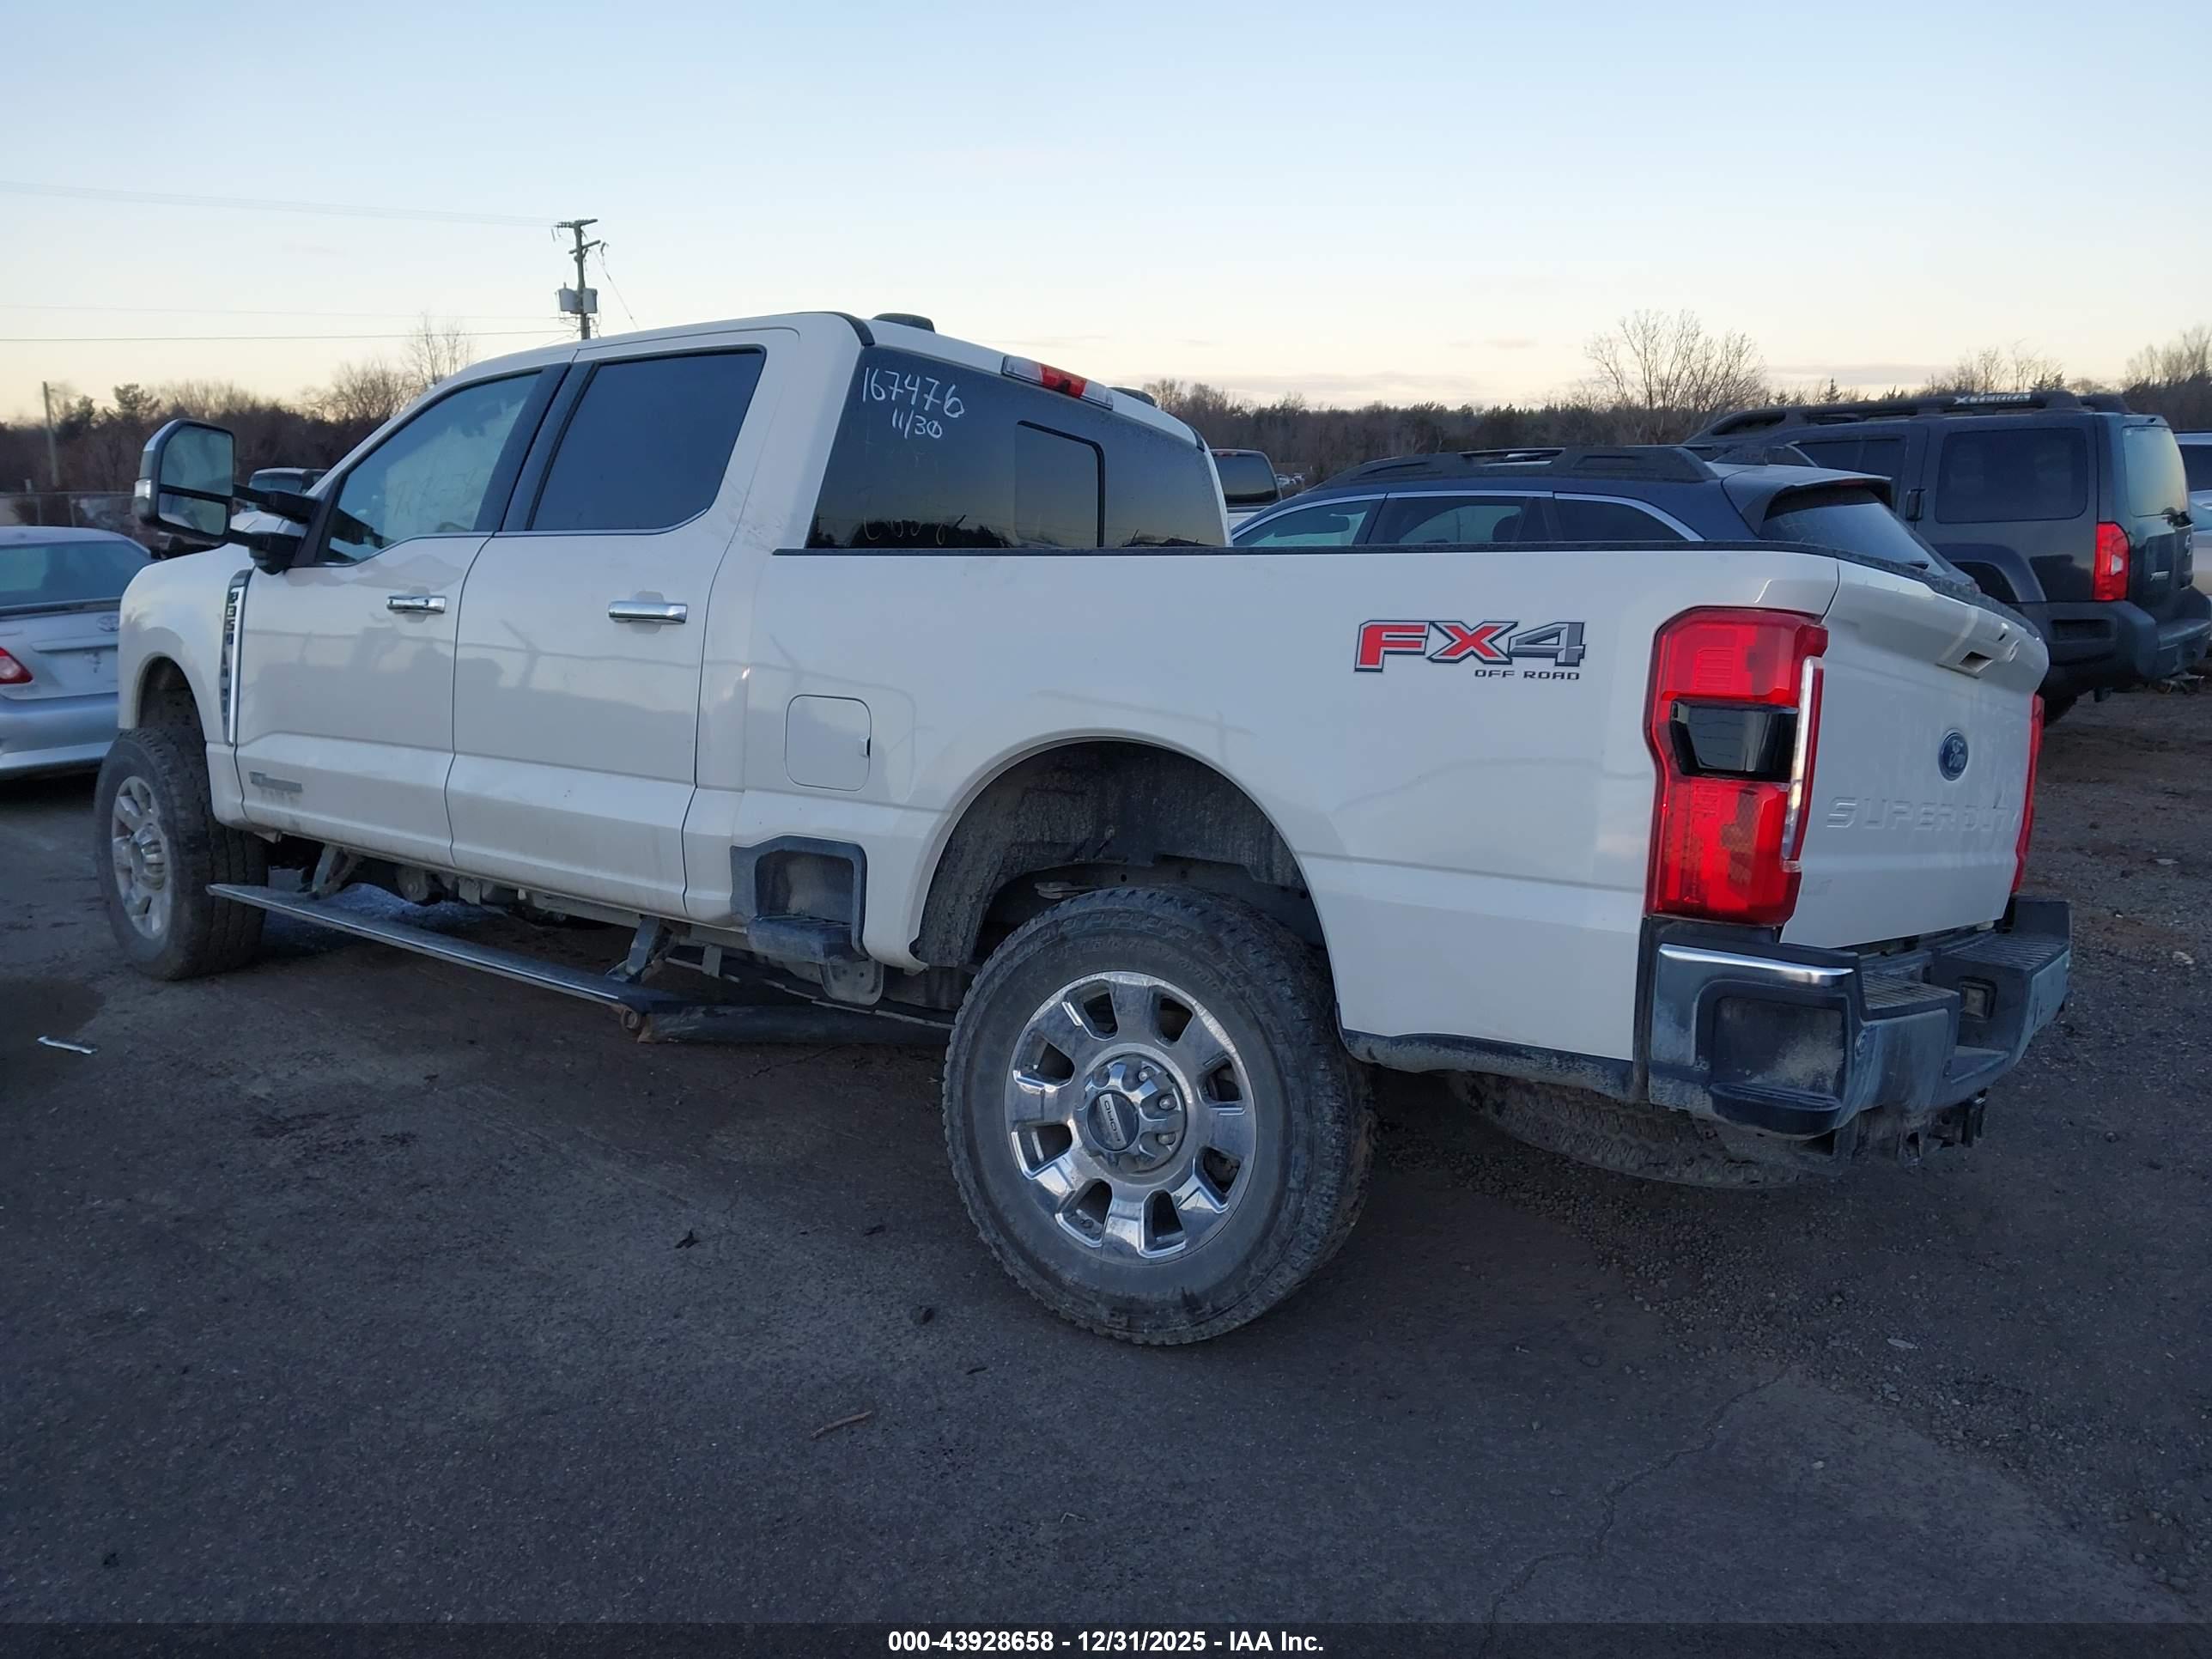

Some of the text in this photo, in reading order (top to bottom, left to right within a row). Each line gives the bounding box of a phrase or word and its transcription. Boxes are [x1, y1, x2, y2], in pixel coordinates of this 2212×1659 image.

[862, 367, 965, 418] 167476
[890, 408, 943, 439] 11/30
[1354, 619, 1586, 672] FX4
[1474, 669, 1580, 681] OFF ROAD
[1826, 795, 1955, 830] SUPER
